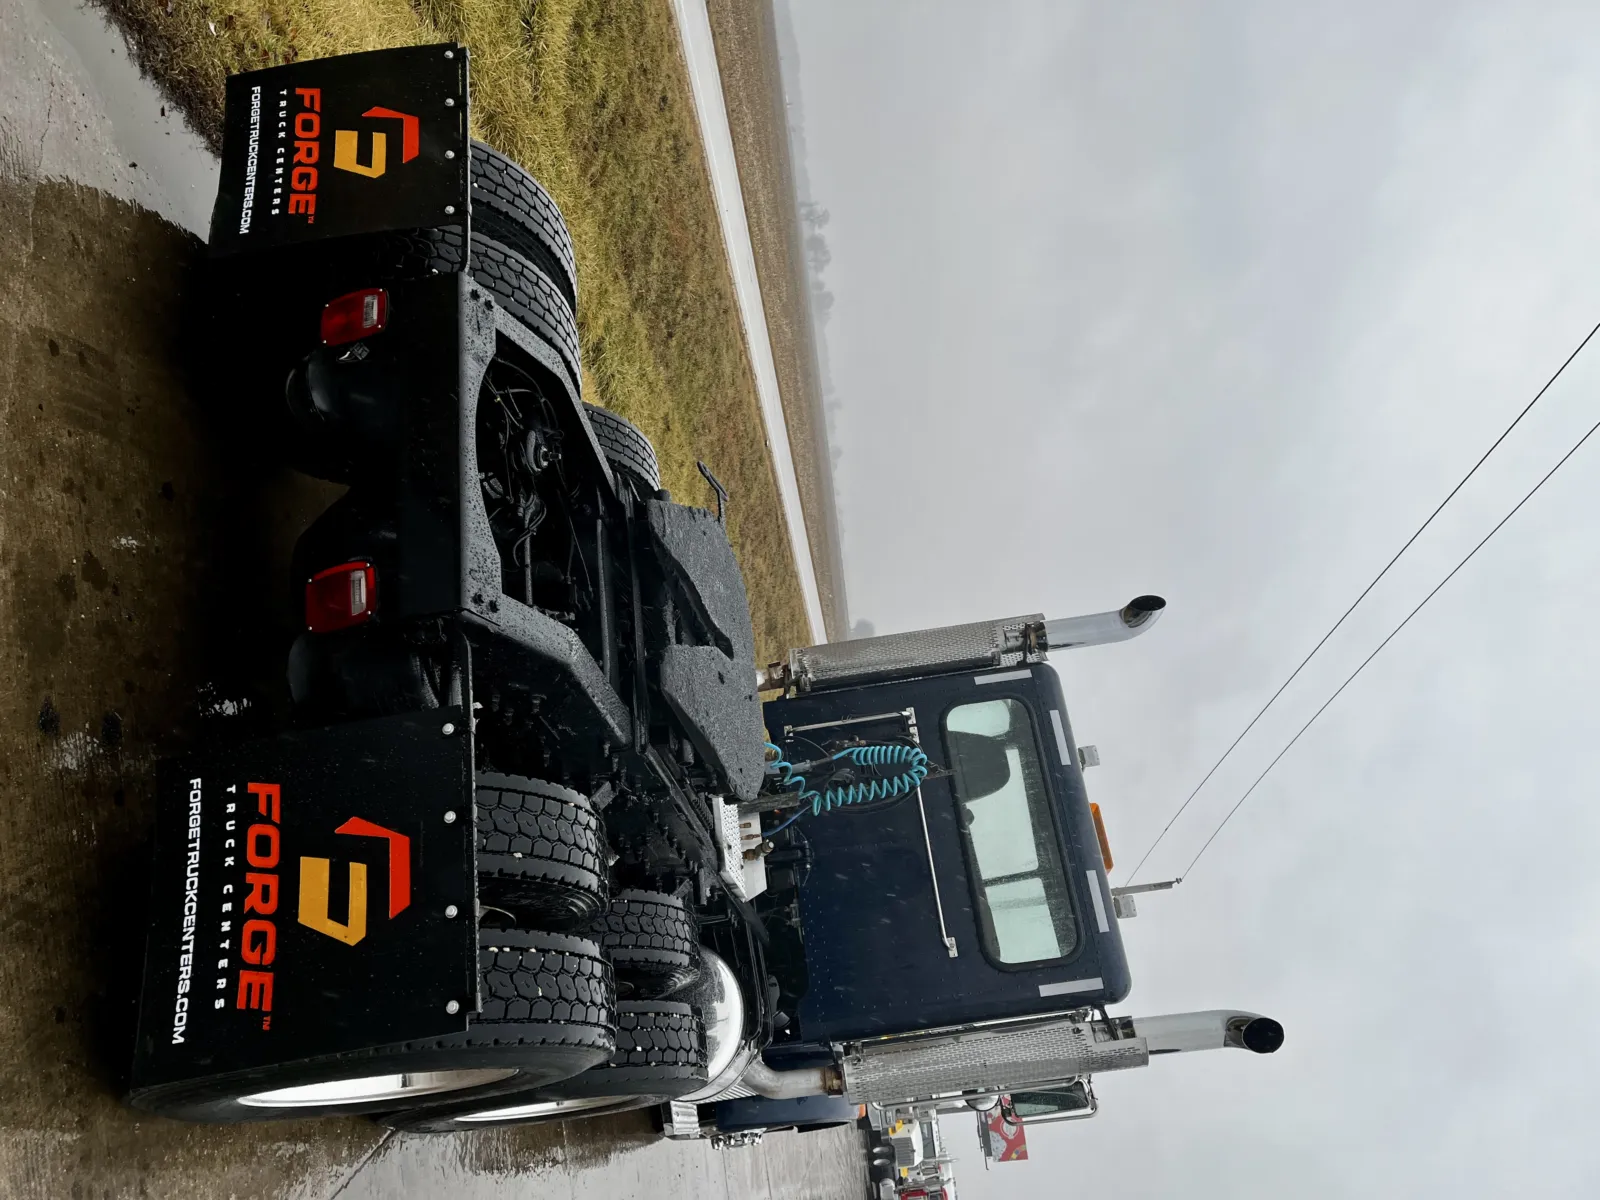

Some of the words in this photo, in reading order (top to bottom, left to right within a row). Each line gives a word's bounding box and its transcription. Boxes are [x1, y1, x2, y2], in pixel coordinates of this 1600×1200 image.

[239, 86, 261, 235] FORGETRUCKCENTERS.COM
[277, 89, 288, 138] TRUCK
[271, 148, 285, 215] CENTERS
[224, 784, 236, 867] TRUCK
[171, 777, 202, 1045] FORGETRUCKCENTERS.COM
[214, 884, 234, 1010] CENTERS
